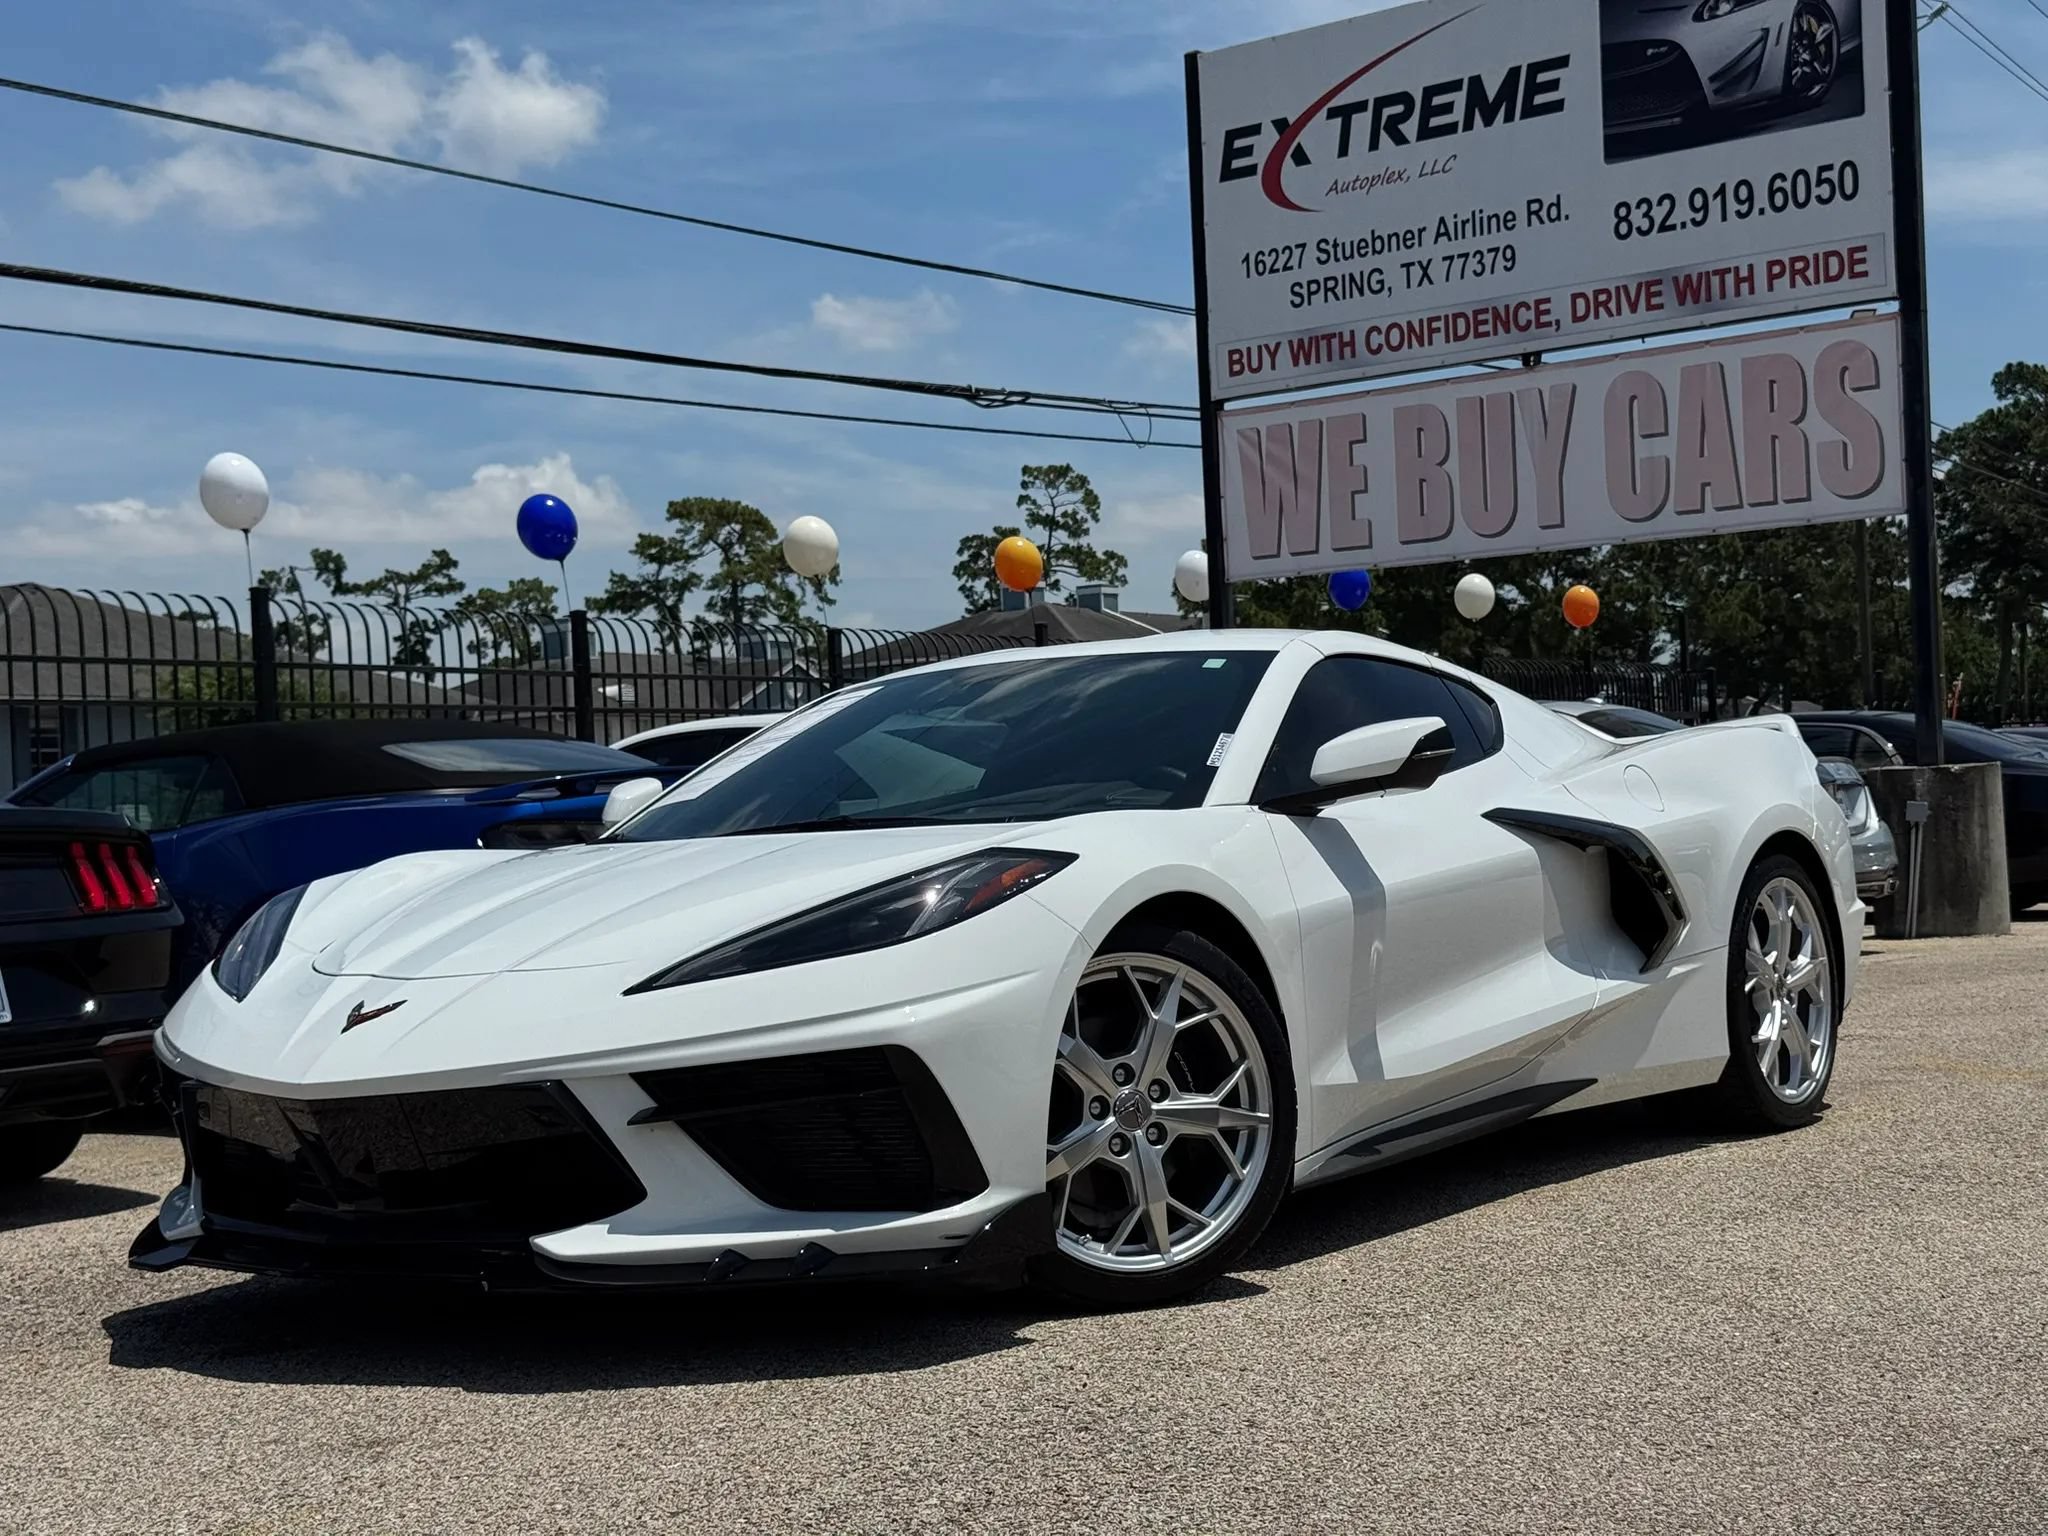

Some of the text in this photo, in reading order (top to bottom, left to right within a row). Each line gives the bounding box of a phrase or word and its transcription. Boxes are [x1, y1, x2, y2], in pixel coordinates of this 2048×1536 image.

[1219, 54, 1571, 184] EXTREME
[1325, 154, 1458, 196] Autoplex, LLC
[1613, 159, 1860, 242] 832.919.6050
[1241, 193, 1570, 279] 16227 Stuebner Airline Rd.
[1289, 244, 1517, 310] SPRING, TX 77379
[1227, 245, 1870, 378] BUY WITH CONFIDENCE, DRIVE WITH PRIDE
[1236, 338, 1885, 561] WE BUY CARS
